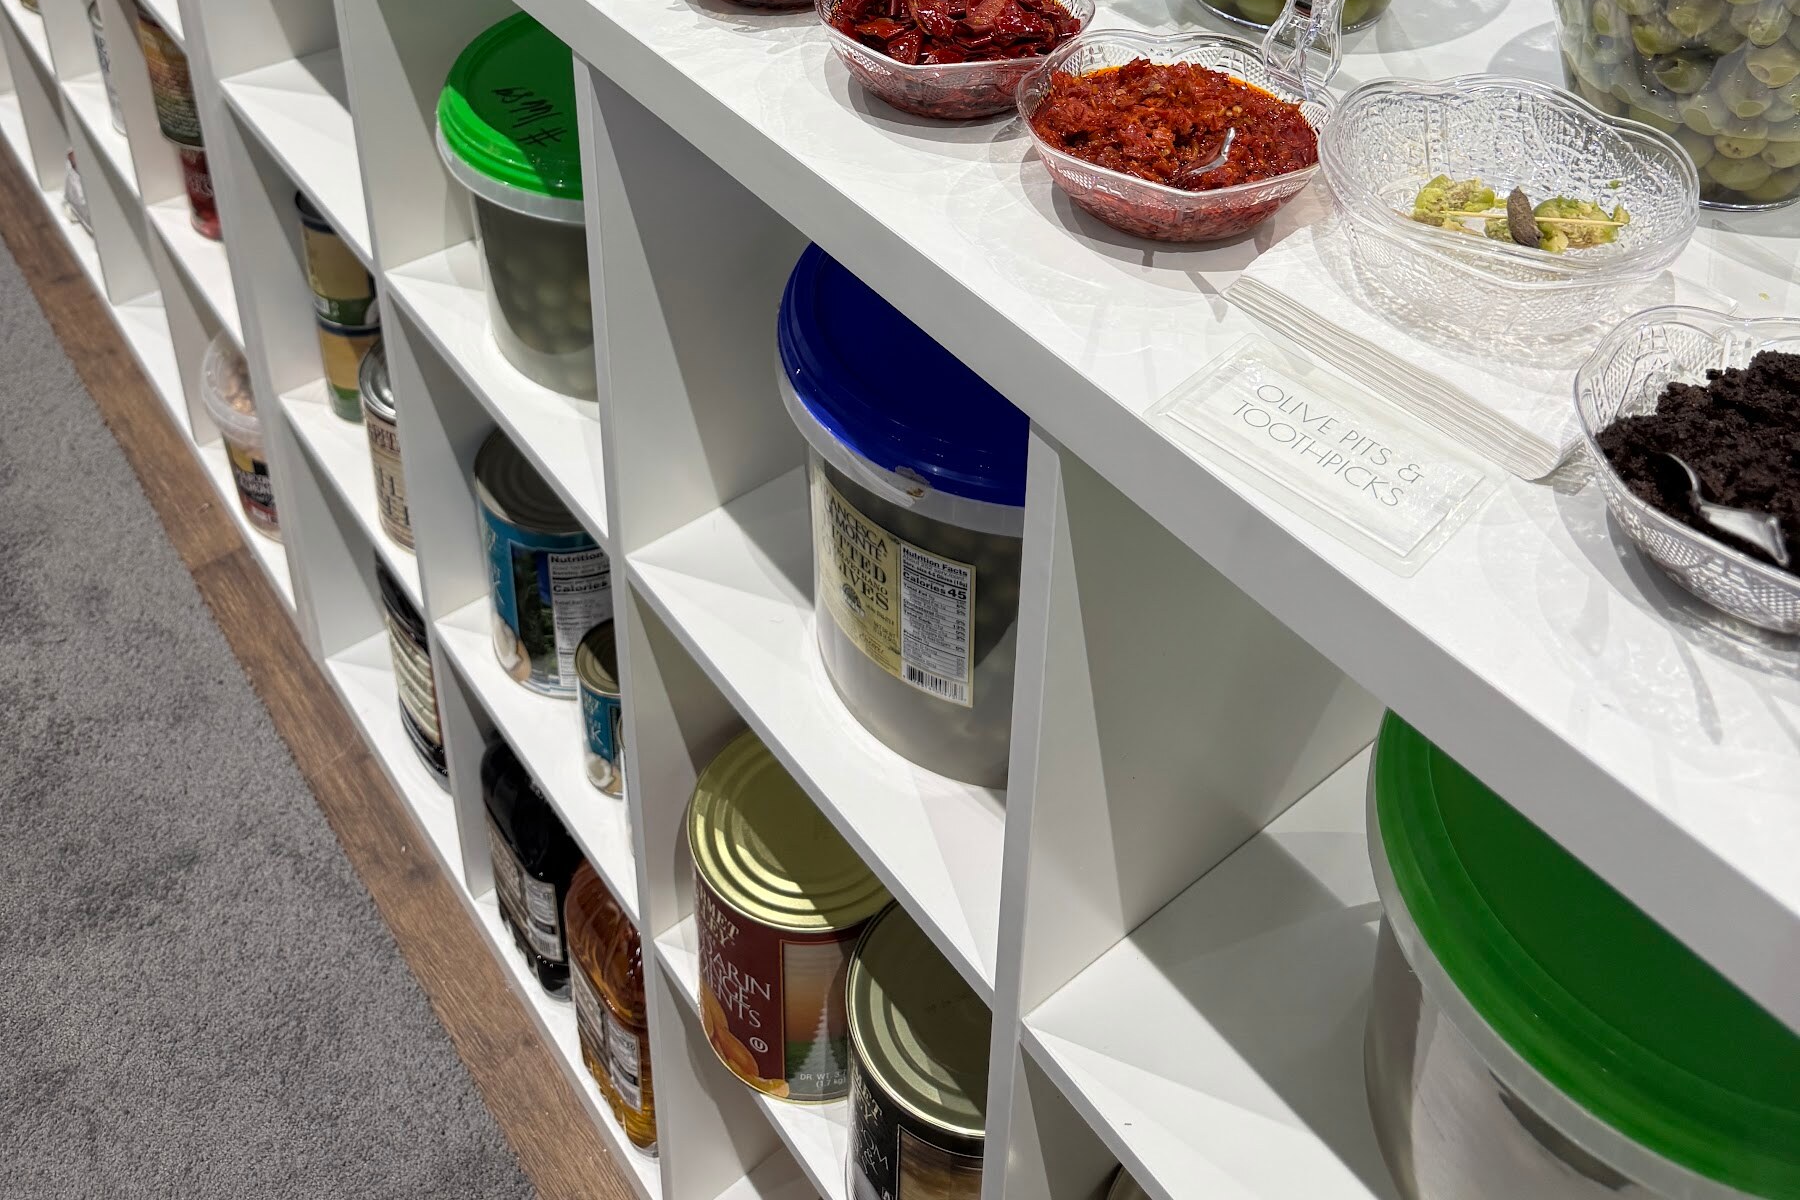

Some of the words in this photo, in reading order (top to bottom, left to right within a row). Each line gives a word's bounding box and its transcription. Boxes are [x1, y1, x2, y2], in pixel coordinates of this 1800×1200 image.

[1256, 384, 1339, 435] OLIVE
[1339, 428, 1393, 466] PITS
[1397, 463, 1425, 485] &
[1232, 399, 1405, 508] TOOTHPICKS
[551, 552, 604, 563] Nutrition
[903, 547, 940, 568] Nutrition
[942, 563, 968, 577] Facts
[553, 581, 608, 593] Calories
[903, 571, 946, 594] Calories
[947, 588, 967, 600] 45
